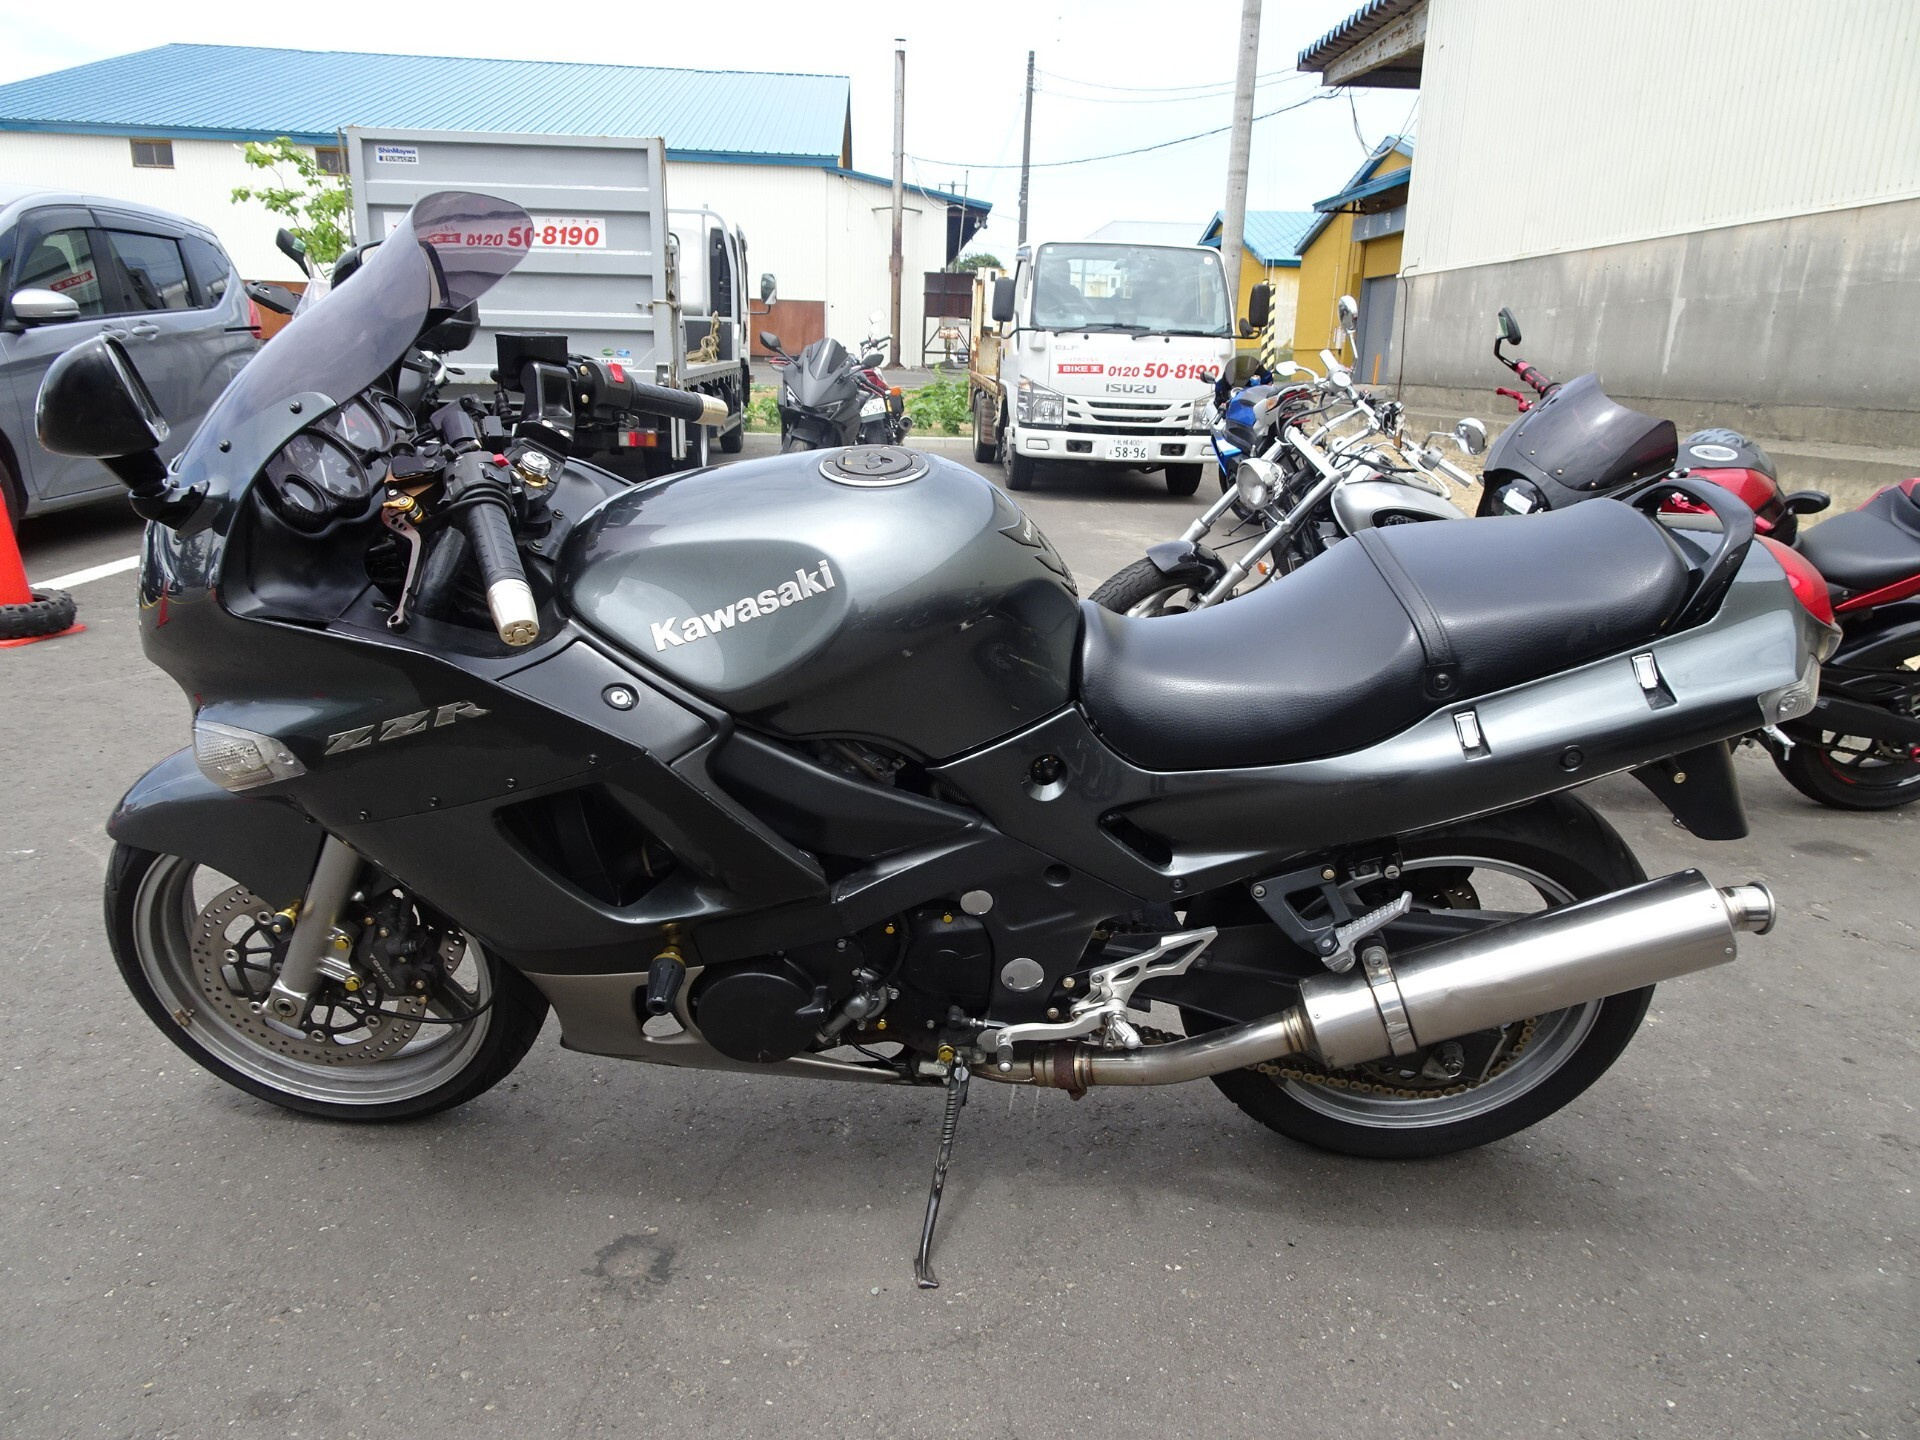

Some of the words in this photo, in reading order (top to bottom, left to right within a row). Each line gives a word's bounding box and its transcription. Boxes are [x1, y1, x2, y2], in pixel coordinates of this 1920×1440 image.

[466, 233, 503, 246] 0120
[1062, 365, 1089, 373] BIKE
[1108, 366, 1140, 377] 0120
[1143, 362, 1219, 380] 50-8190
[1105, 383, 1157, 394] ISUZU
[1115, 446, 1146, 459] 58-96
[650, 560, 835, 652] Kawasaki
[325, 700, 490, 756] ZZR
[369, 952, 396, 989] TOKICO
